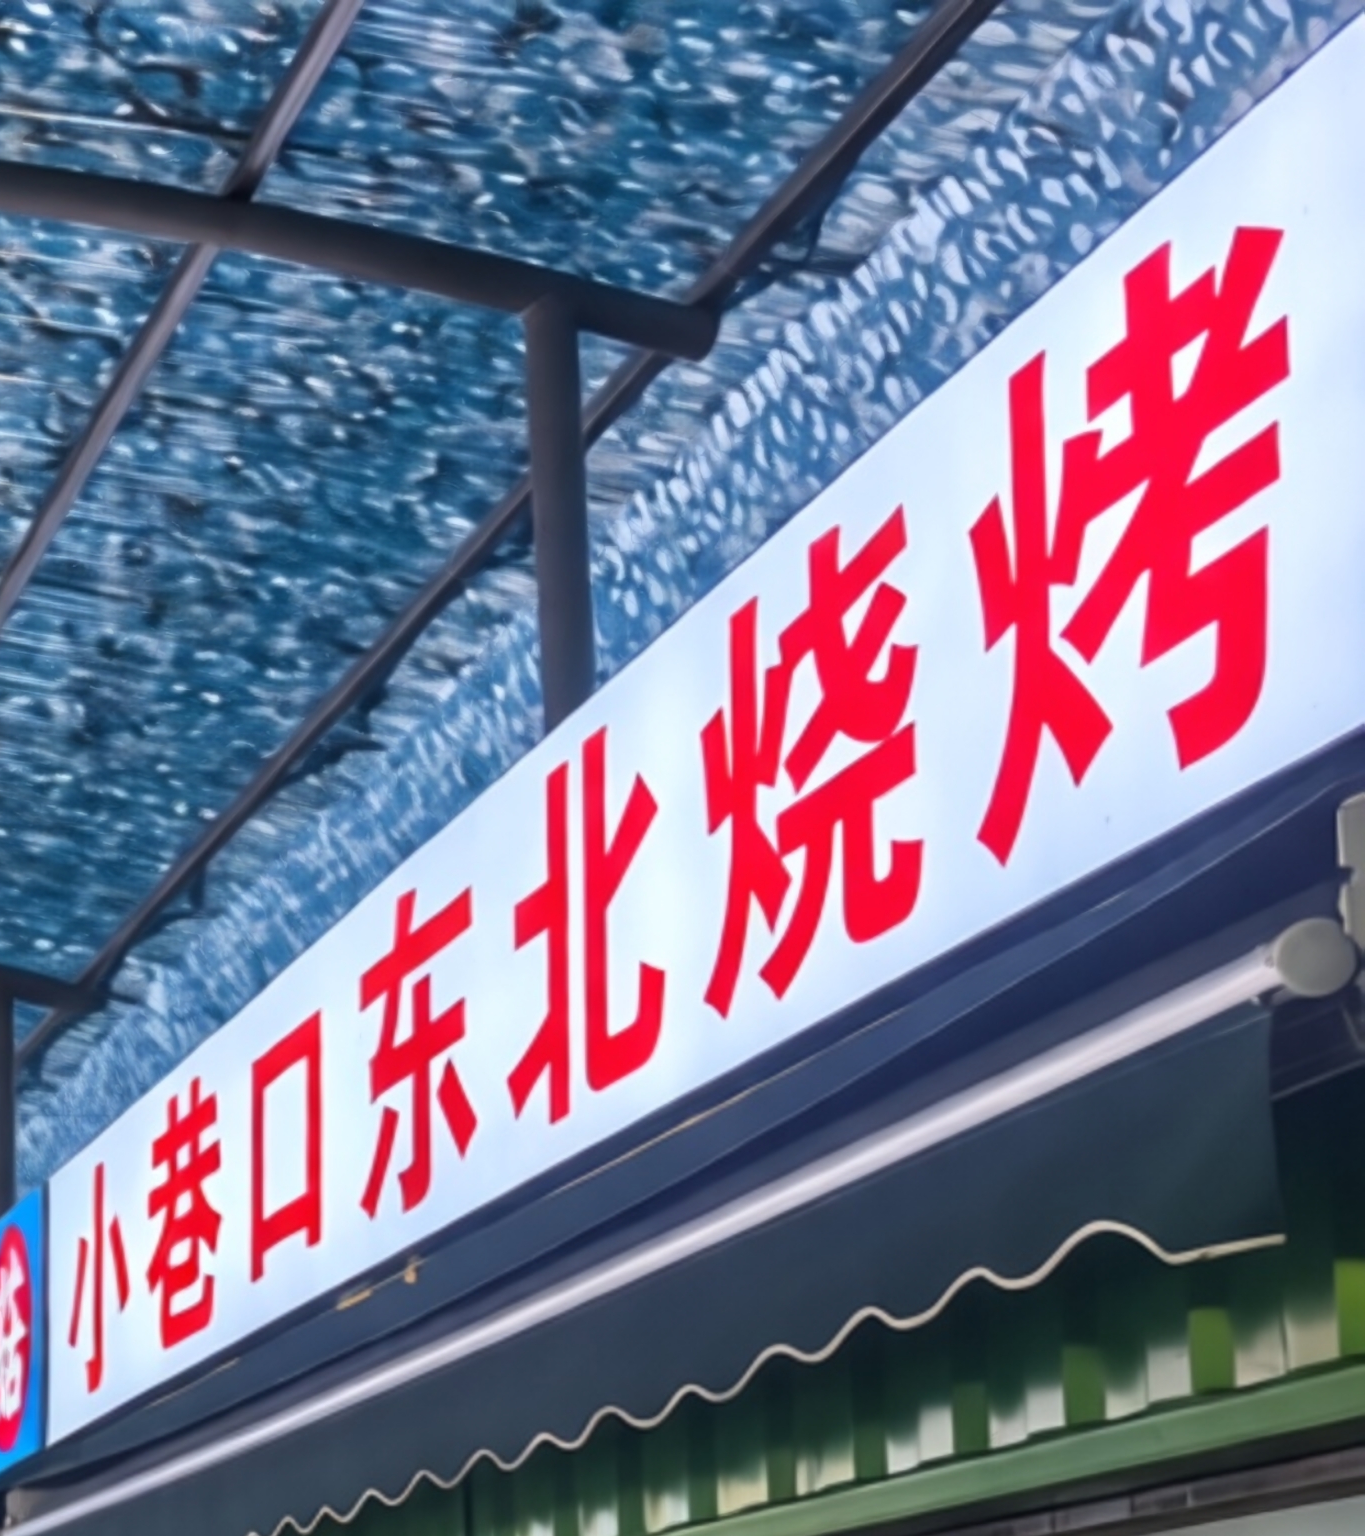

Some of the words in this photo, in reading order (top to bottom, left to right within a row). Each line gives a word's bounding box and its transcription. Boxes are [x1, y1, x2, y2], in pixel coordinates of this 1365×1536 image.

[69, 224, 1291, 1395] 小巷口东北烧烤
